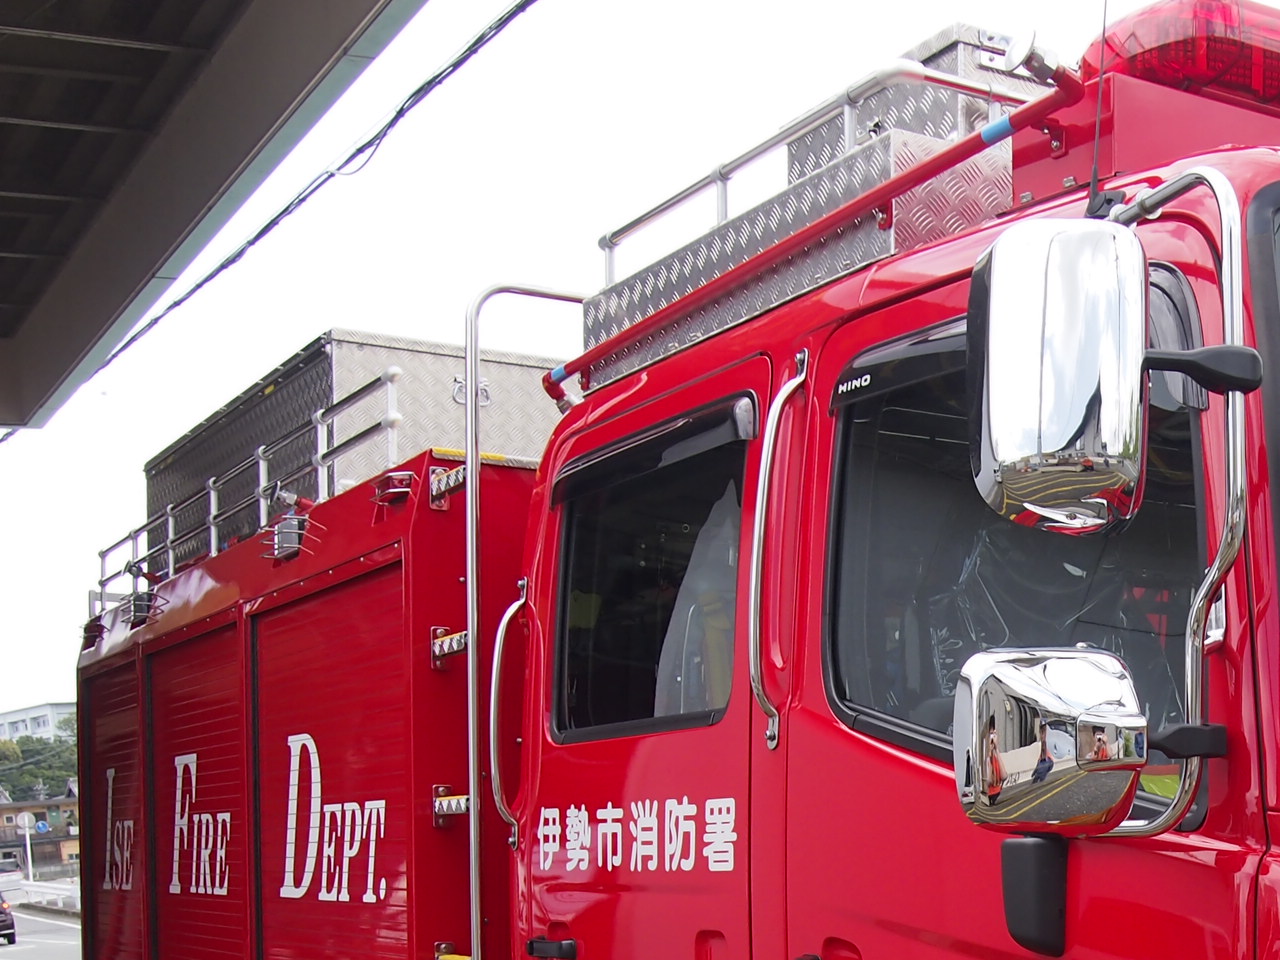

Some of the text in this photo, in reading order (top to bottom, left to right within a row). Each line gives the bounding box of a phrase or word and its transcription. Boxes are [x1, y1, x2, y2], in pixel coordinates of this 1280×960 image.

[838, 374, 871, 394] HINO
[103, 733, 387, 904] ISE FIRE DEPT.
[537, 795, 738, 873] 伊勢市消防署
